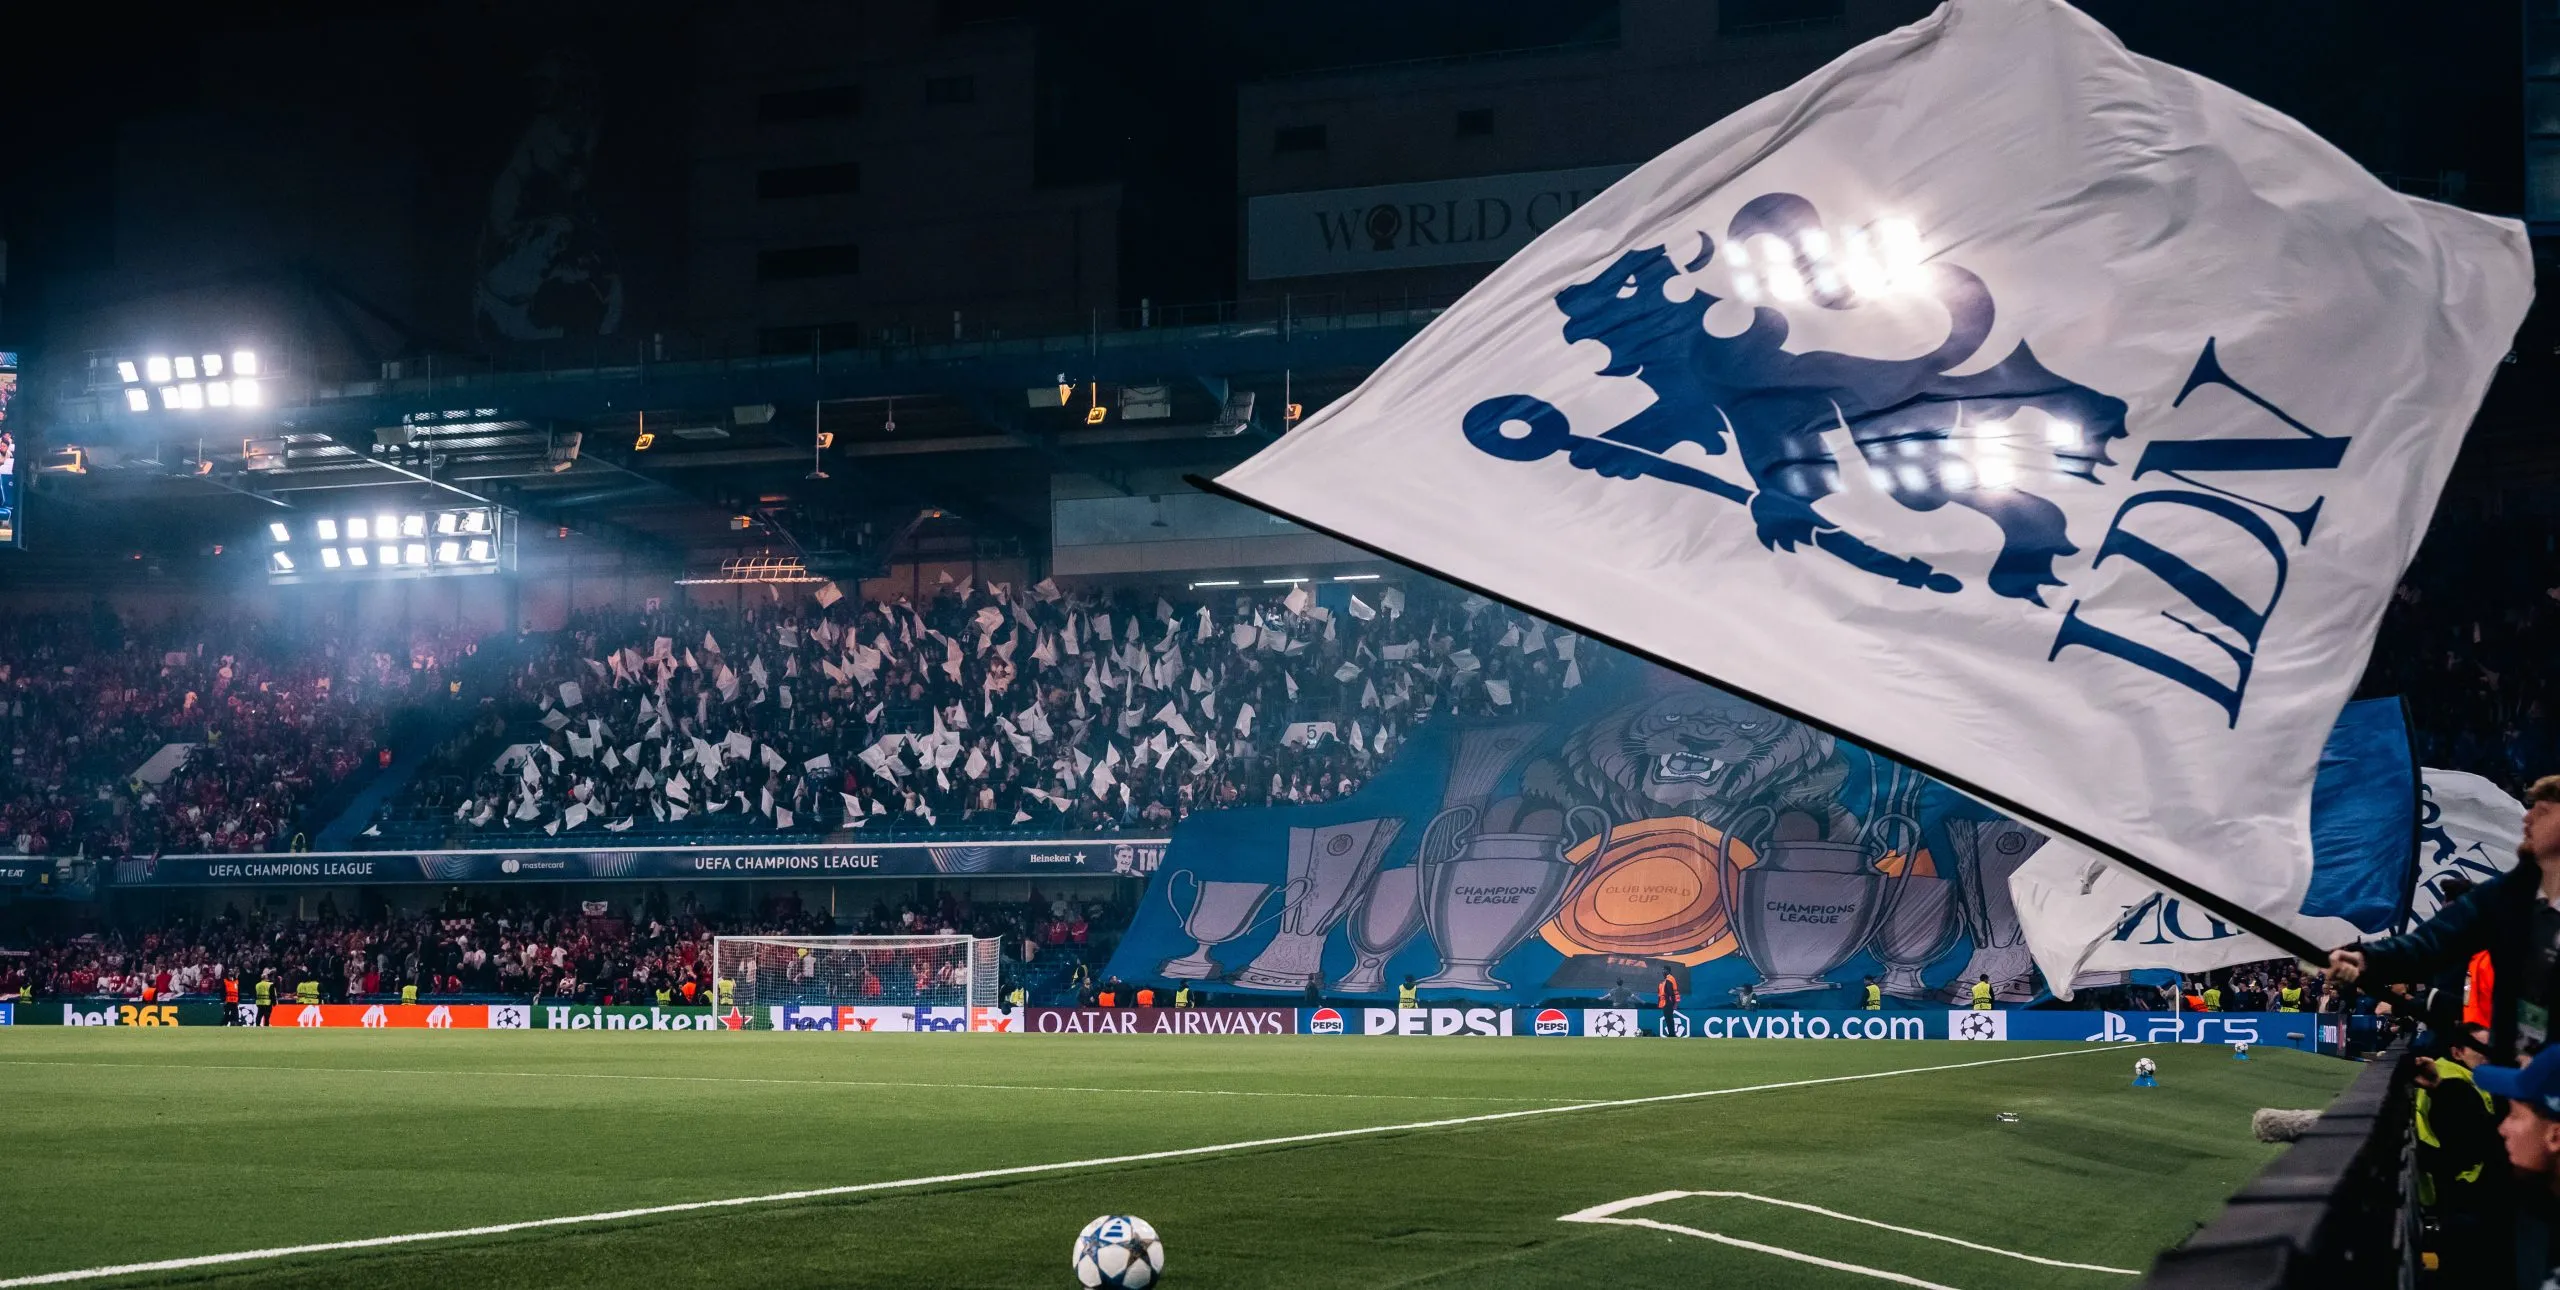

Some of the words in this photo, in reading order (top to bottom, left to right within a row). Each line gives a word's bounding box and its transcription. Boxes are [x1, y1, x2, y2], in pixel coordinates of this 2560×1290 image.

[2048, 336, 2352, 729] LDN
[1306, 724, 1317, 740] 5
[522, 861, 565, 869] mastercard
[695, 857, 731, 870] UEFA
[735, 856, 819, 869] CHAMPIONS
[824, 855, 879, 868] LEAGUE
[1030, 853, 1071, 863] Heineken
[7, 869, 25, 877] EAT
[208, 864, 241, 877] UEFA
[244, 863, 319, 876] CHAMPIONS
[324, 862, 374, 875] LEAGUE
[1455, 886, 1537, 896] CHAMPIONS
[1605, 885, 1640, 894] CLUB
[1643, 885, 1691, 897] WORLD
[1628, 894, 1660, 903] CUP
[1465, 895, 1521, 904] LEAGUE
[1766, 901, 1856, 914] CHAMPIONS
[1779, 912, 1840, 924] LEAGUE
[63, 1004, 178, 1027] bet365
[546, 1006, 714, 1030] Heineken
[783, 1006, 877, 1031] FedEx
[914, 1007, 1012, 1032] FedEx
[1038, 1011, 1138, 1034] QATAR
[1153, 1011, 1283, 1035] AIRWAYS
[1364, 1008, 1513, 1036] PEPSI
[1312, 1021, 1342, 1030] PEPSI
[1536, 1022, 1567, 1031] PEPSI
[1703, 1011, 1925, 1040] crypto.com
[2148, 1017, 2259, 1043] PS5
